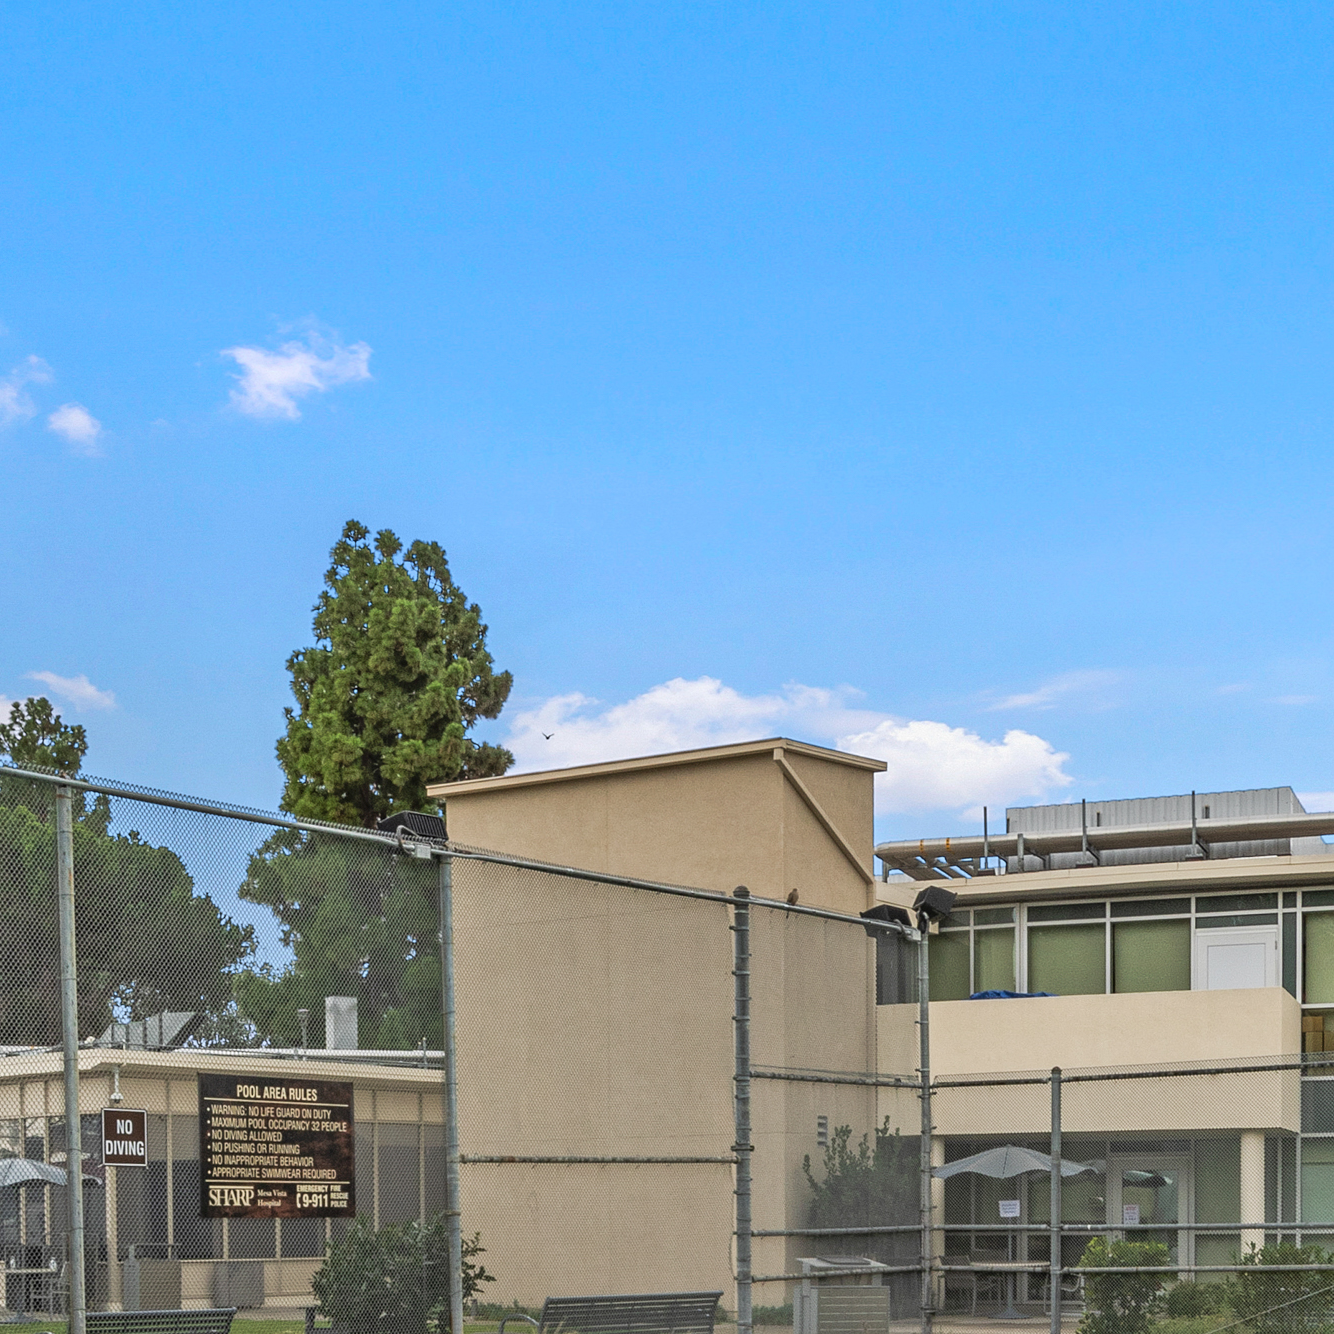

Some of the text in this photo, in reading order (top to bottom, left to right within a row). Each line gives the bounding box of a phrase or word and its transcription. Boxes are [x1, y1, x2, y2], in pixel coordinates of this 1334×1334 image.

[237, 1085, 317, 1101] POOL AREA RULES
[211, 1104, 331, 1119] WARNING: NO LIFE GUARD ON DUTY
[116, 1119, 133, 1135] NO
[211, 1118, 347, 1132] MAXIMUM POOL OCCUPANCY 32 PEOPLE
[212, 1130, 282, 1142] NO DIVING ALLOWED
[105, 1139, 144, 1156] DIVING
[212, 1142, 300, 1154] NO PUSHING OR RUNNING
[212, 1155, 314, 1167] NO INAPPROPRIATE BEHAVIOR
[212, 1167, 336, 1179] APPROPRIATE SWIMWEAR REQUIRED
[209, 1189, 254, 1206] SHARP
[257, 1200, 281, 1208] Hospital
[303, 1194, 328, 1207] 9-911
